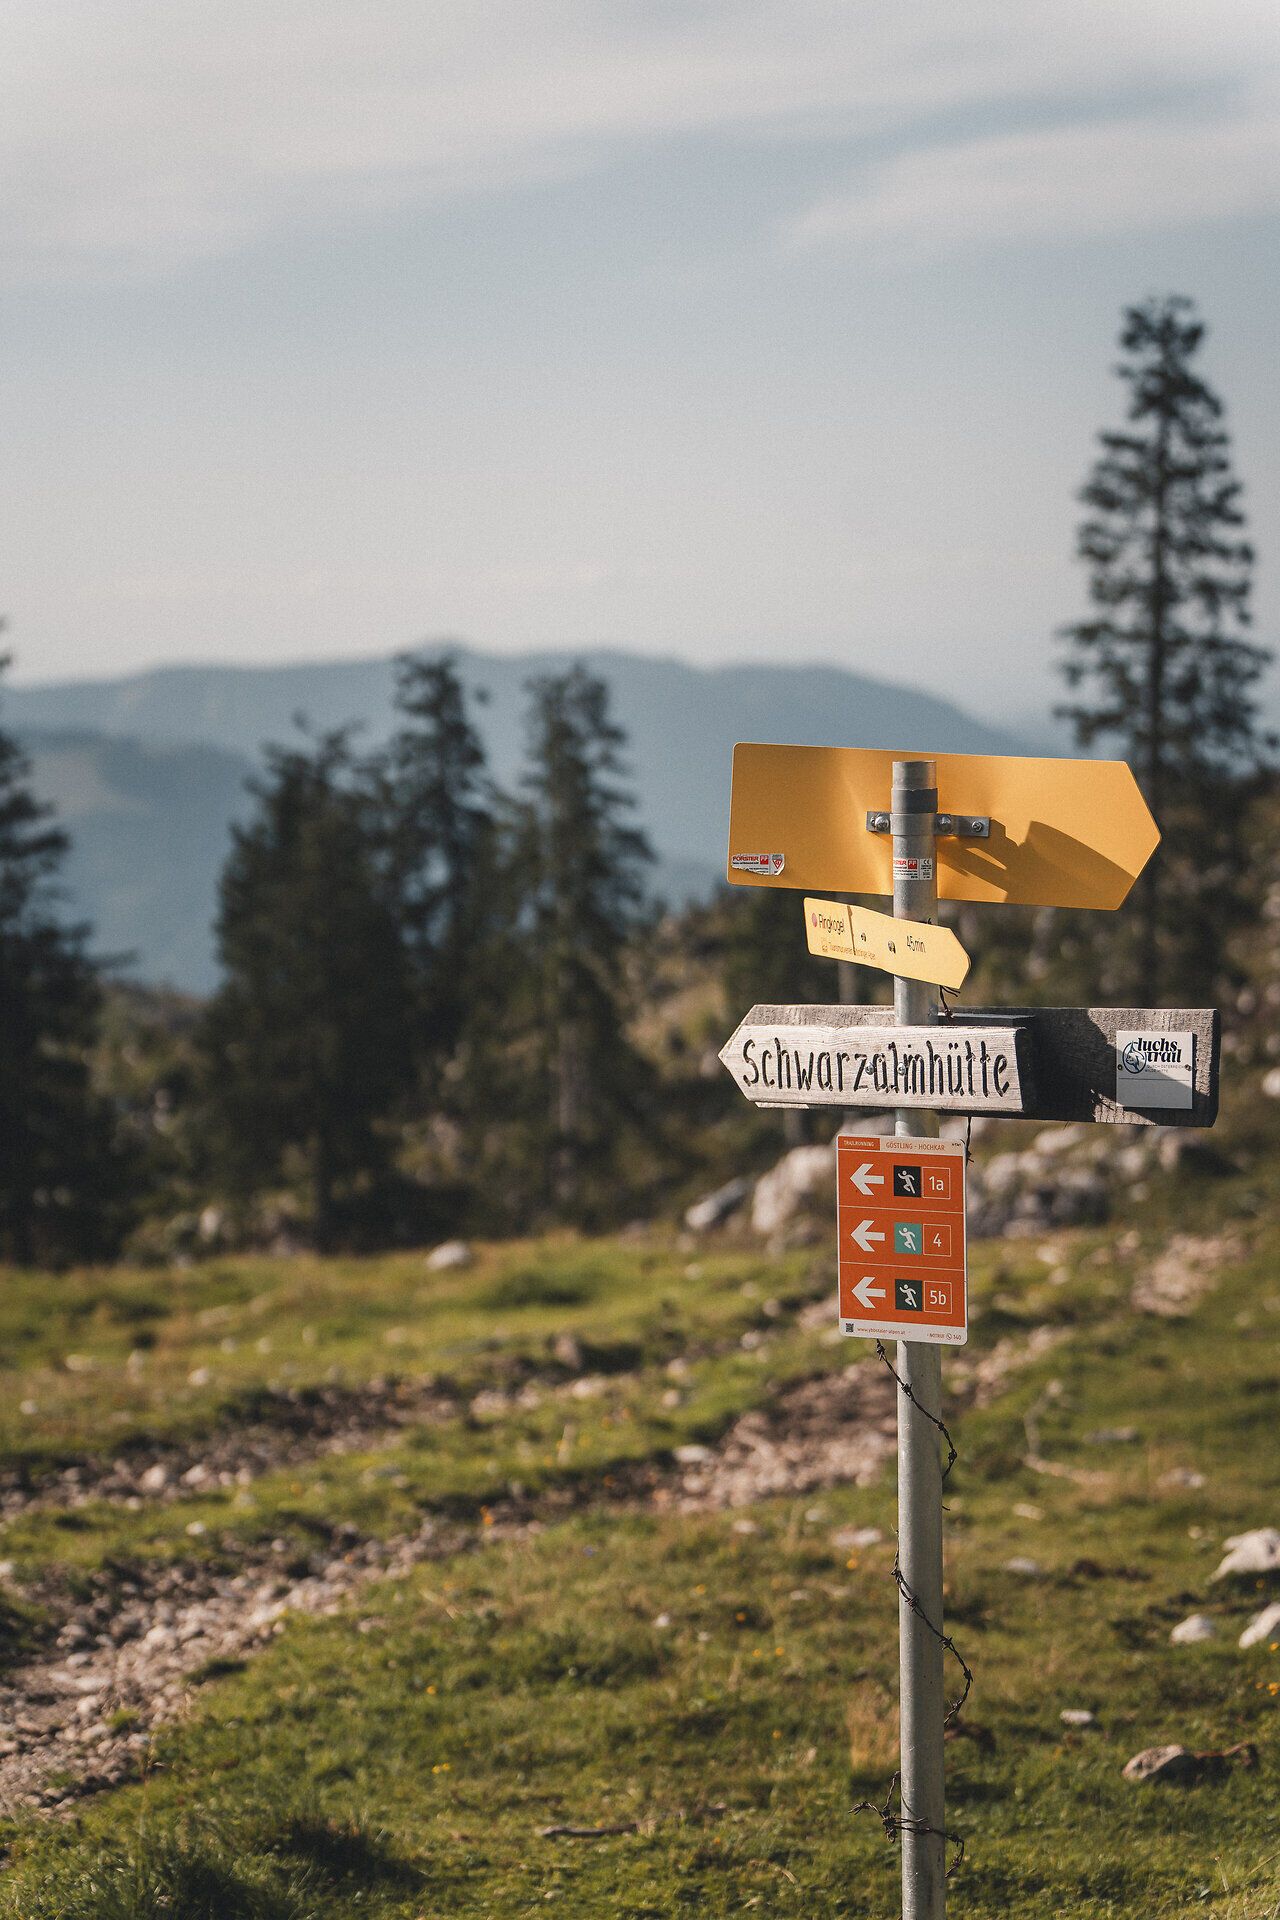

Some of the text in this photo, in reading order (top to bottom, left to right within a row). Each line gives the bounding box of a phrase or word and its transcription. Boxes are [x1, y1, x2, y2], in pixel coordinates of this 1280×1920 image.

[1137, 1038, 1178, 1052] luchs
[1146, 1049, 1182, 1063] trail
[742, 1037, 1010, 1097] Schwarzalmhütte
[918, 1143, 945, 1151] HOCHKAR
[928, 1175, 944, 1191] 1a
[933, 1233, 942, 1248] 4
[929, 1290, 947, 1305] 5b
